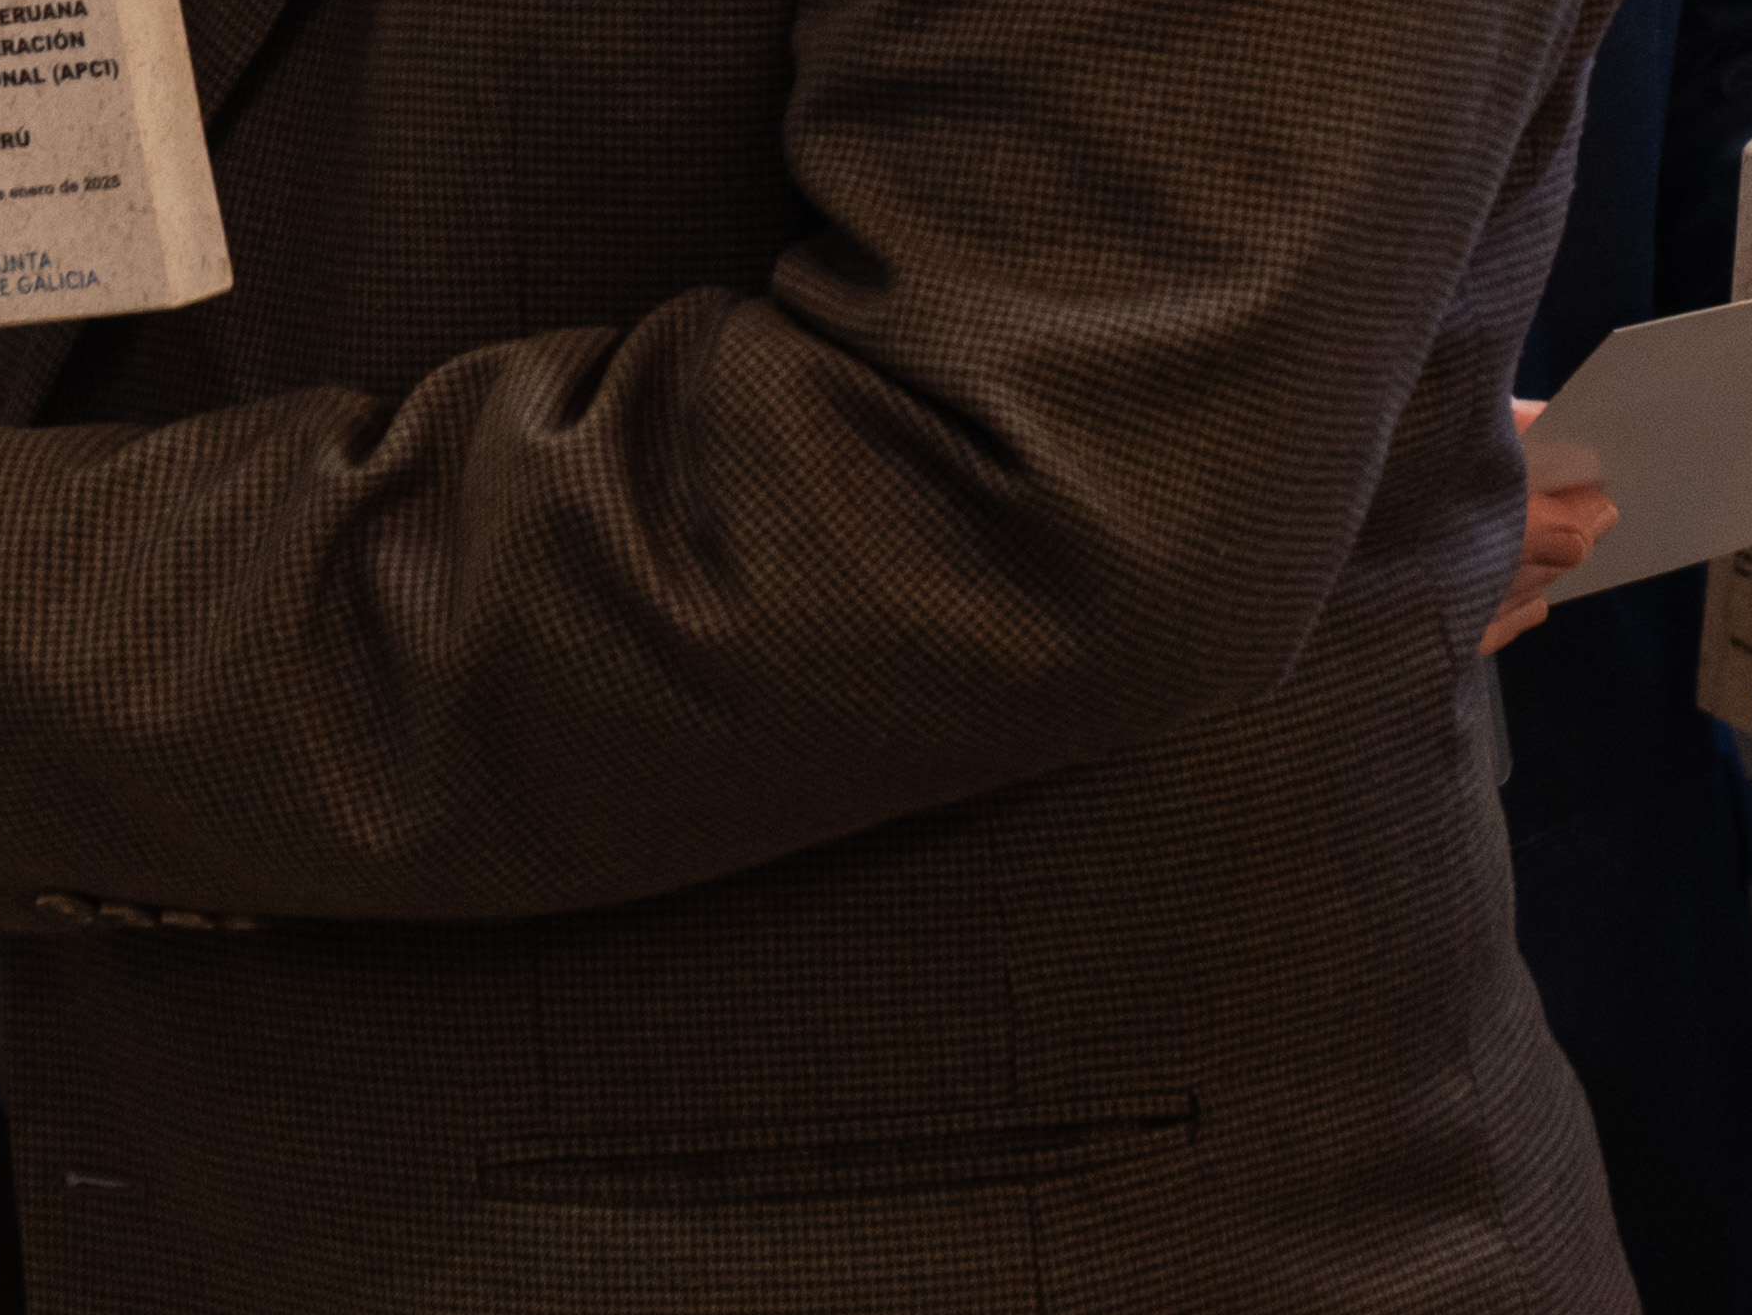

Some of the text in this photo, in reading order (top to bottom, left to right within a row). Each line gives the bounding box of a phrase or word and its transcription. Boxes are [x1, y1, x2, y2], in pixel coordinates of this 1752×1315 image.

[53, 59, 119, 85] (APCI)
[9, 184, 55, 198] enero
[60, 180, 79, 194] de
[17, 270, 100, 295] GALICIA
